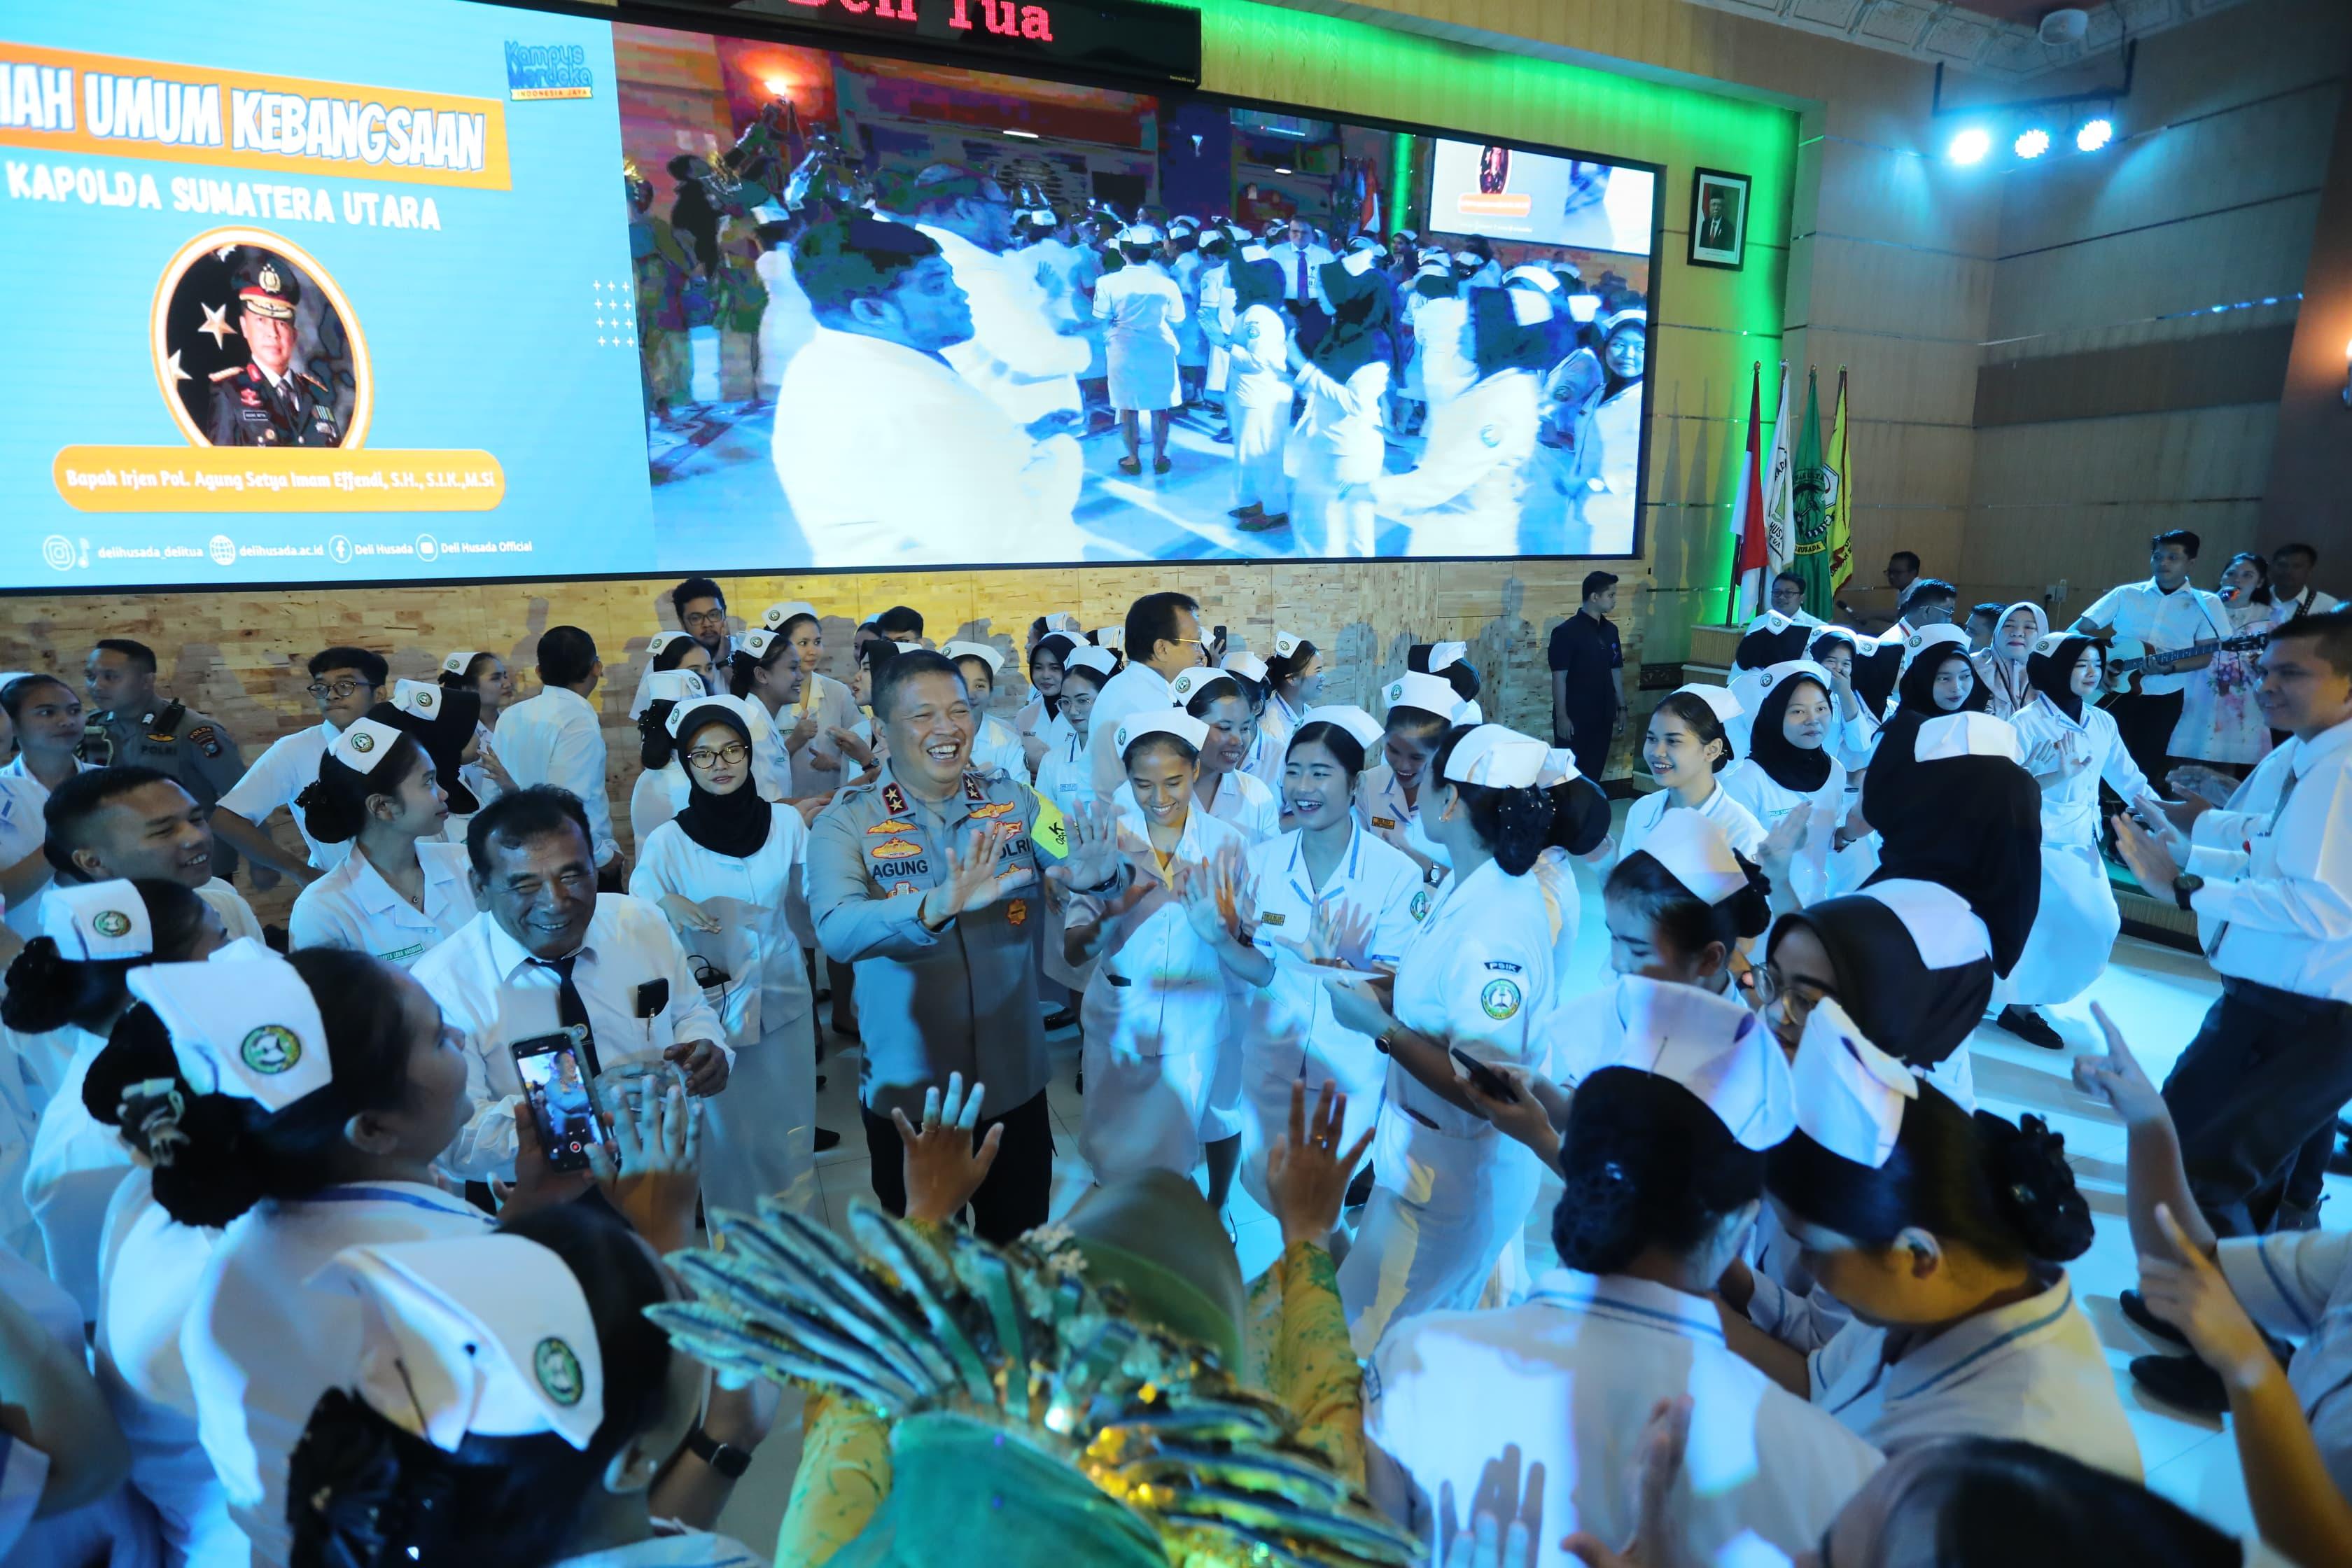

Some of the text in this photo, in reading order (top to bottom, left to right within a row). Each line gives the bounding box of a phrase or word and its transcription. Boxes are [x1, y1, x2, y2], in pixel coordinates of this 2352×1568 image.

[504, 41, 584, 71] Kampus
[83, 71, 223, 147] UMUM
[230, 87, 486, 172] KEBANGSAAN
[6, 160, 442, 231] KAPOLDA SUMATERA UTARA
[65, 468, 118, 491] Bapak
[120, 469, 158, 490] Irjen
[195, 470, 244, 491] Agung
[246, 470, 288, 491] Setya
[290, 470, 331, 488] Imam
[98, 546, 203, 559] delihusada_delitua
[239, 545, 324, 556] delihusada.ac.id
[355, 543, 414, 555] Deli Husada
[441, 540, 533, 554] Deli Husada Official
[872, 860, 929, 879] AGUNG
